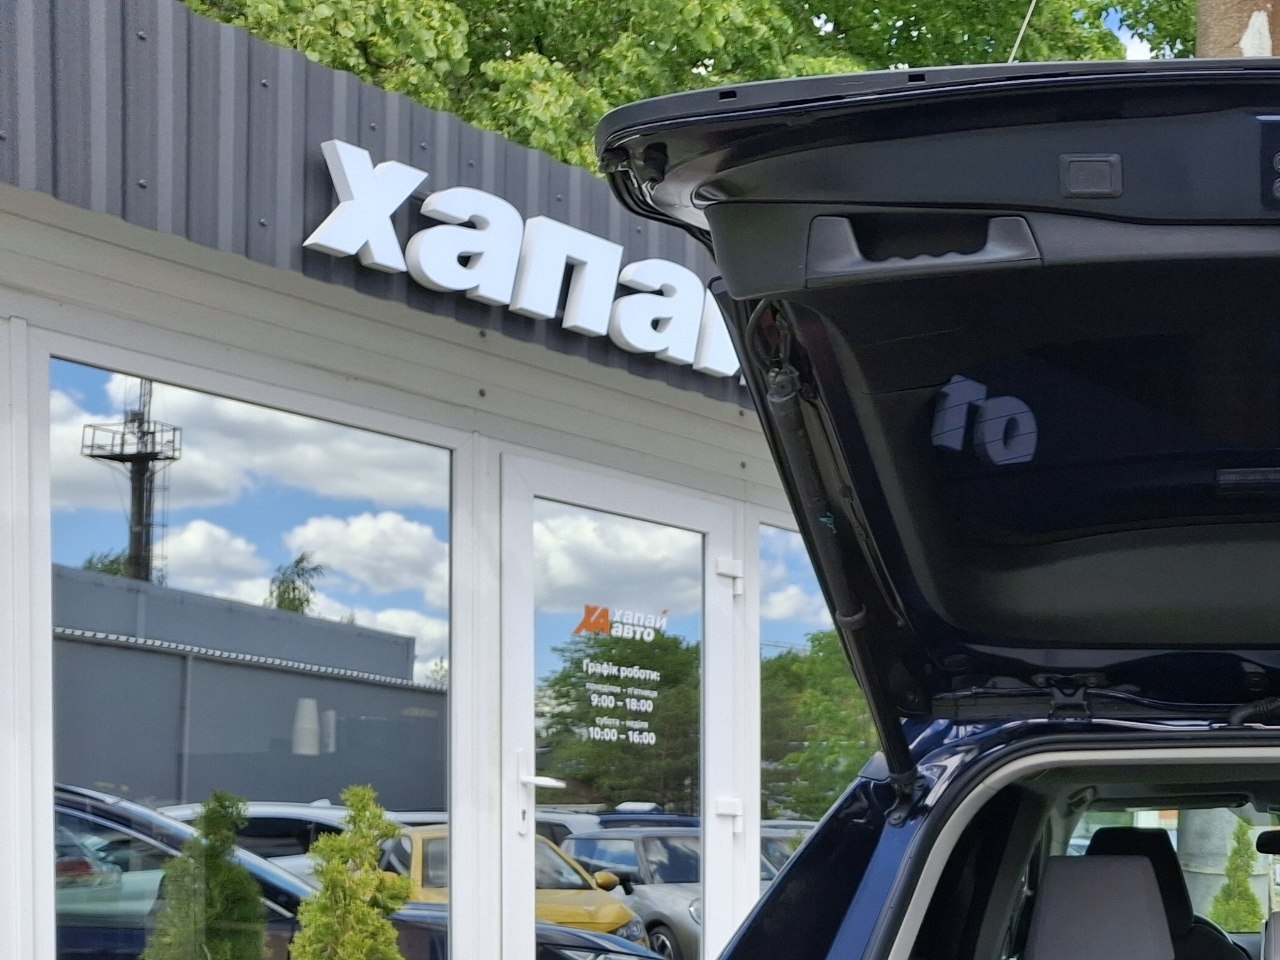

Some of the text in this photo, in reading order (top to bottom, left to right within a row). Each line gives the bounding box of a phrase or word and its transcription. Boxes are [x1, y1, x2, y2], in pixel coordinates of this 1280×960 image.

[612, 608, 669, 630] хапай
[611, 622, 656, 643] авто
[590, 693, 615, 709] 9:00
[625, 697, 654, 713] 18:00
[588, 727, 618, 742] 10:00
[627, 731, 656, 745] 16:00
